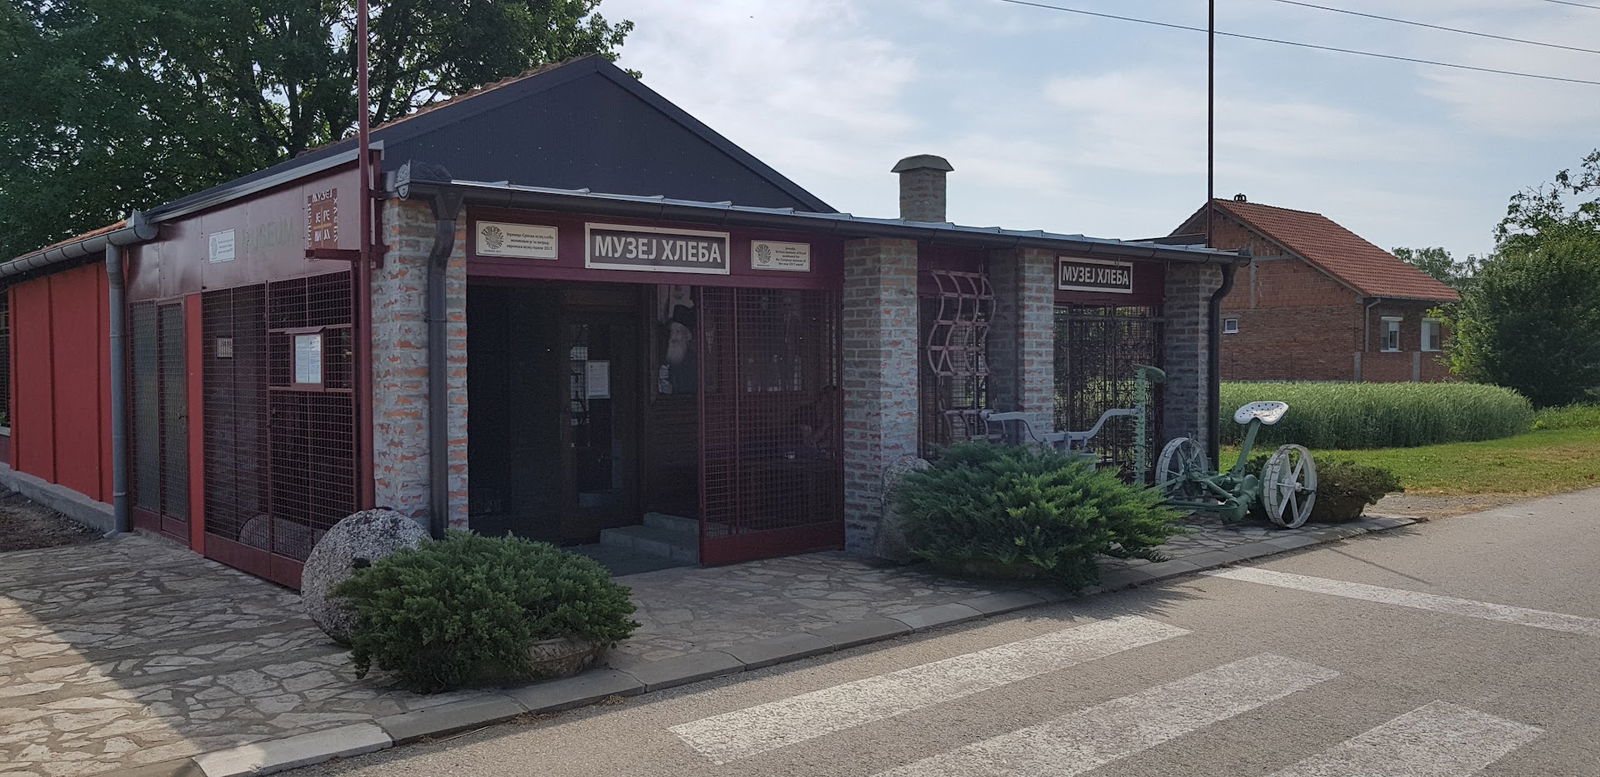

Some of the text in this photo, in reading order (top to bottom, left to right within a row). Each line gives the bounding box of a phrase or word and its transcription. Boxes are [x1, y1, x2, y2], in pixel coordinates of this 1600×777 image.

[595, 235, 722, 263] МУЗЕЈ ХЛЕБА
[1063, 266, 1129, 285] МУЗЕЈ ХЛЕБА
